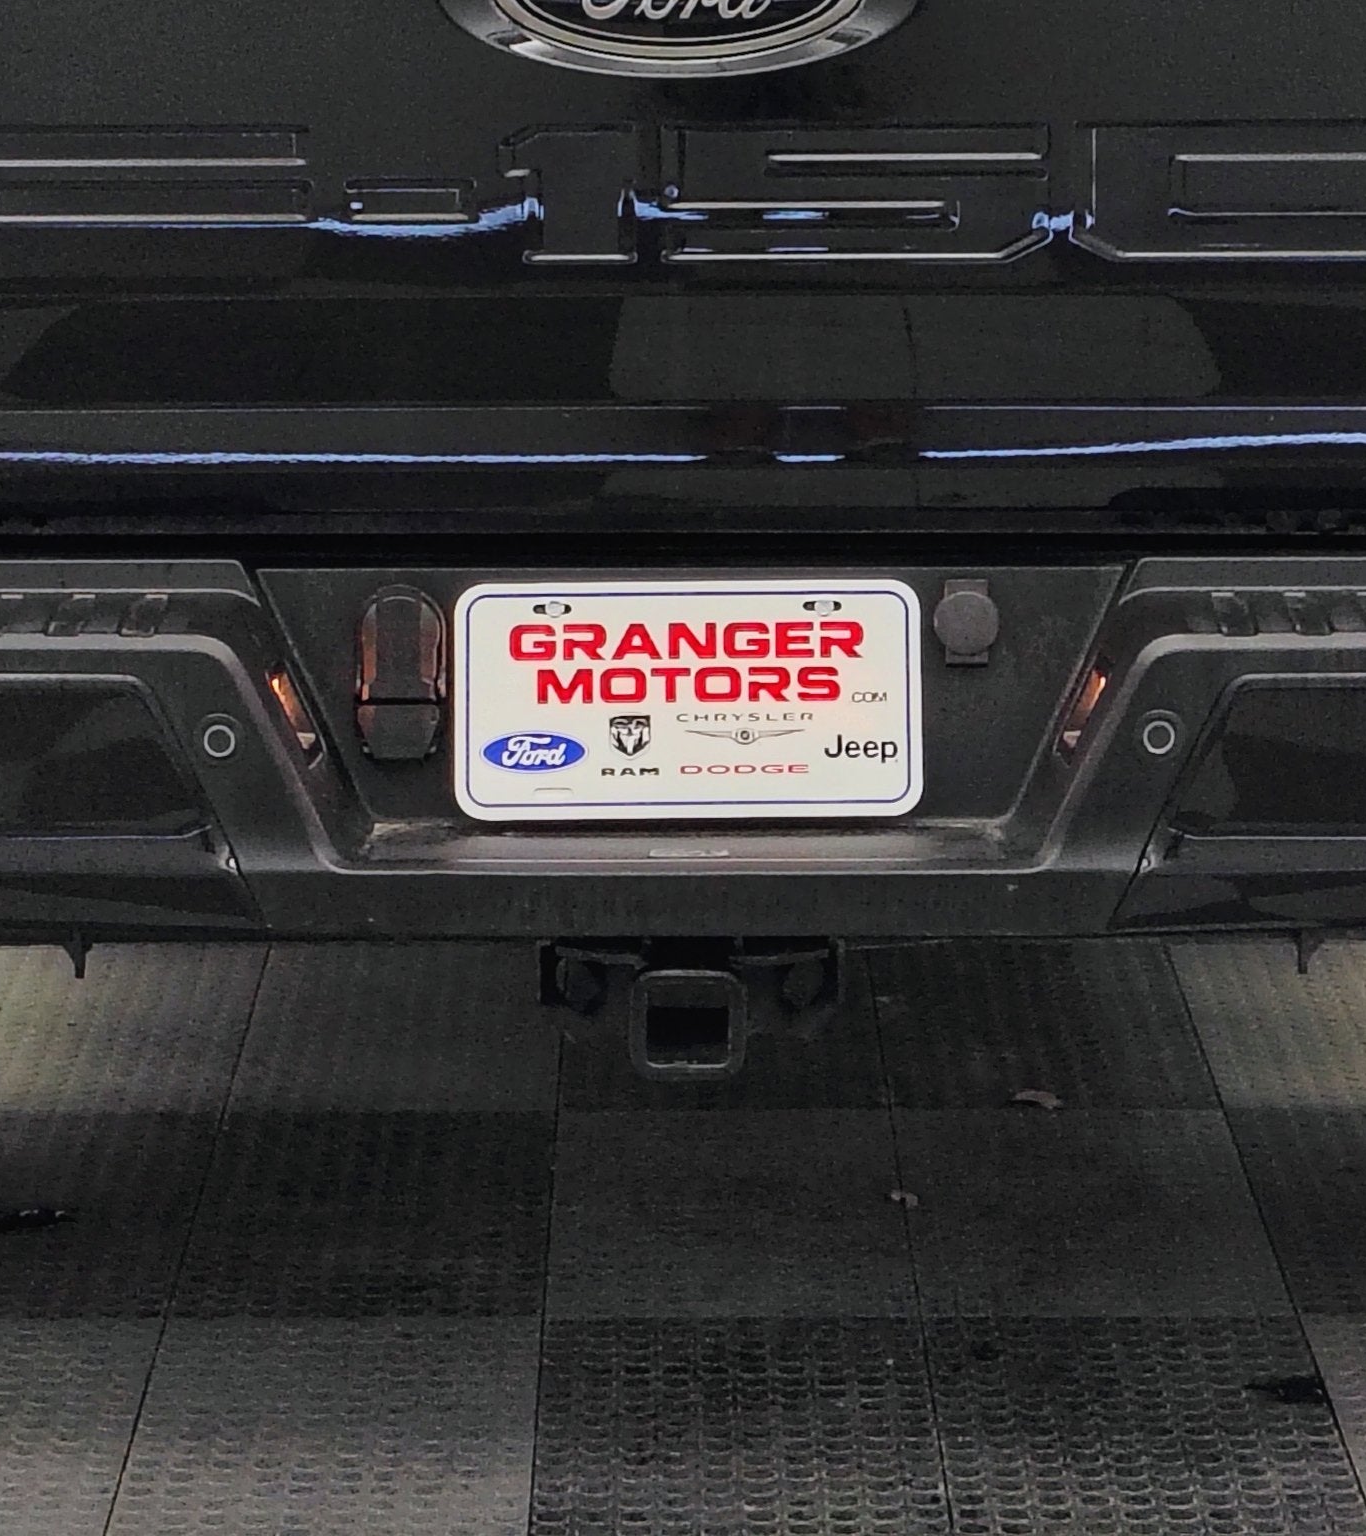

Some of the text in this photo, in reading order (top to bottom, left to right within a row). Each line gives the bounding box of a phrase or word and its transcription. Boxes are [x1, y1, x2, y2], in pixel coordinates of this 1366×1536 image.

[510, 622, 864, 661] GRANGER
[537, 667, 841, 704] MOTORS
[676, 713, 814, 722] CHRYSLER
[501, 737, 567, 768] Ford
[824, 734, 898, 764] Jeep
[601, 768, 660, 776] RAM
[680, 765, 810, 774] DODGE
